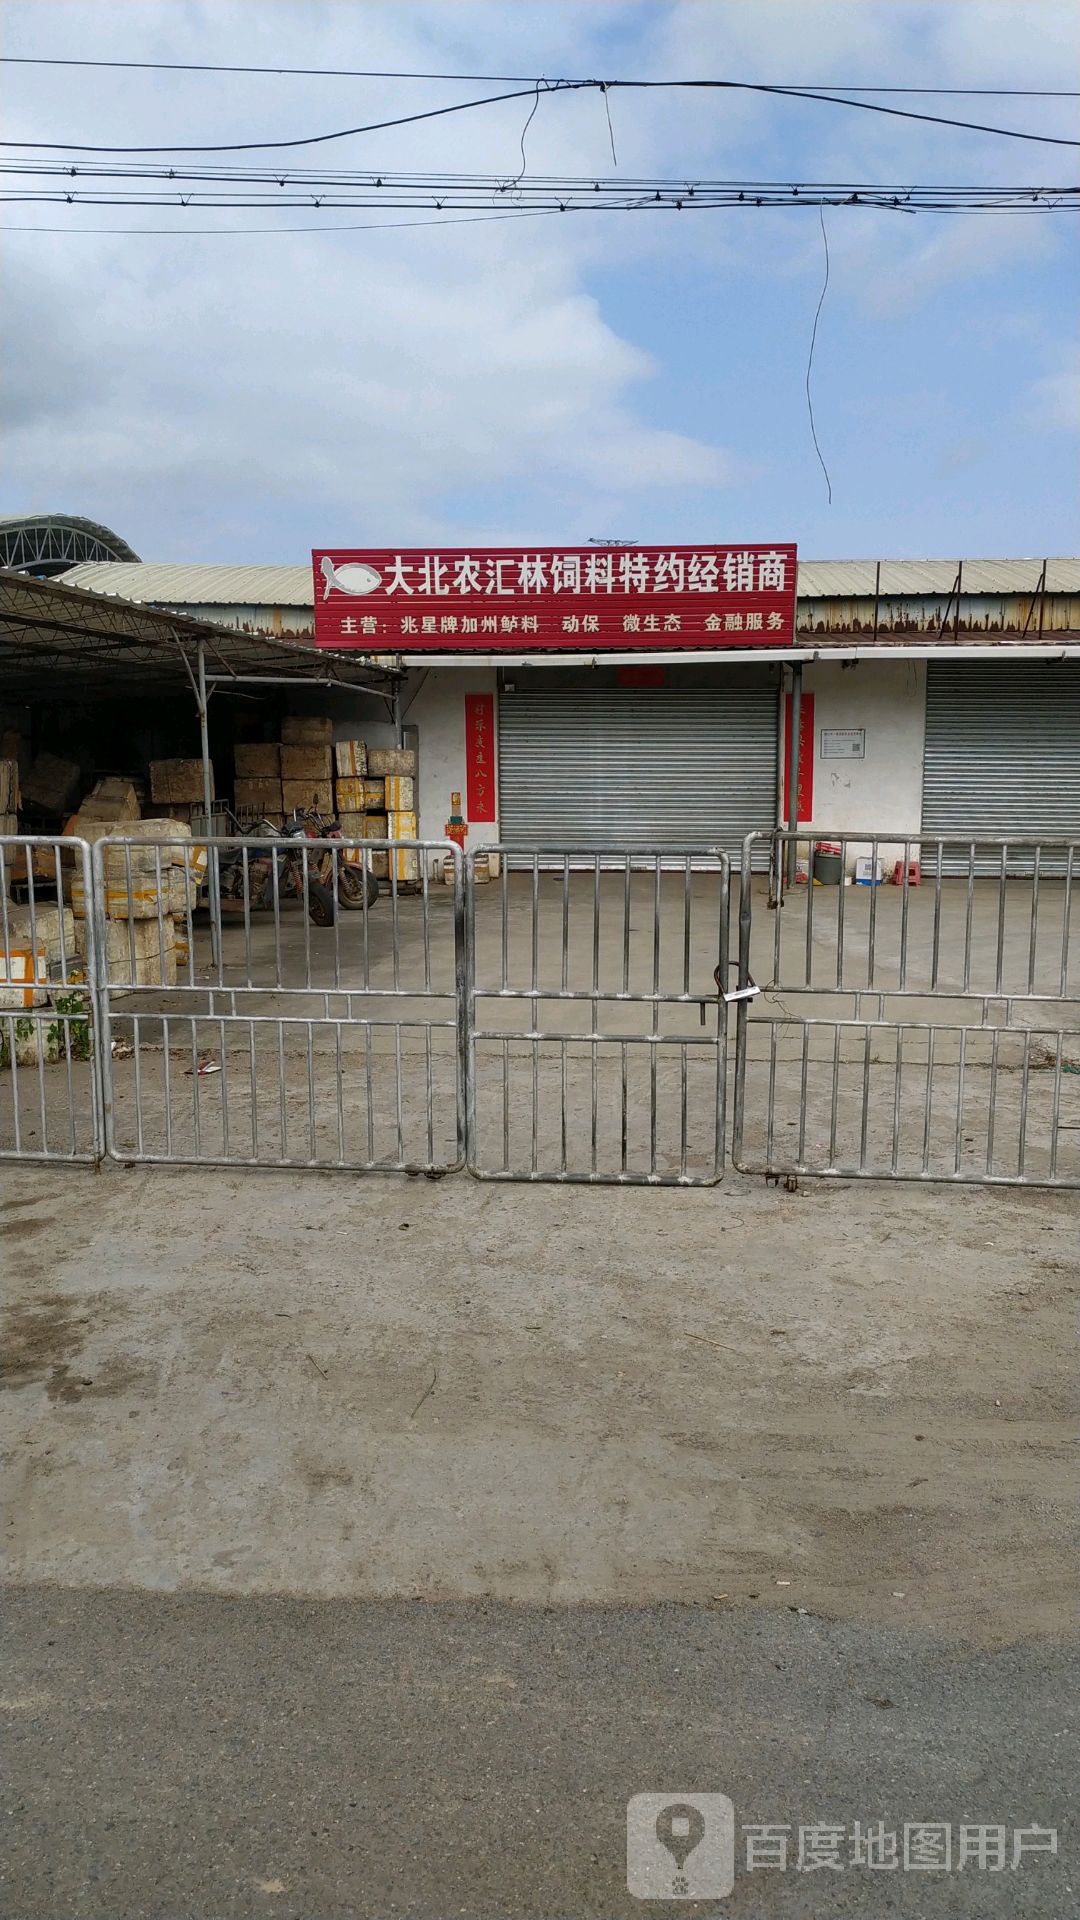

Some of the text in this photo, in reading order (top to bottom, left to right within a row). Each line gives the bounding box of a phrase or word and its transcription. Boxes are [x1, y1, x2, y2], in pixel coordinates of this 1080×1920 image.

[384, 551, 788, 595] 大北农汇林饲料特约经销商
[401, 615, 539, 634] 兆星牌加州鲈料
[562, 614, 600, 633] 动保
[623, 613, 682, 632] 微生态
[704, 611, 785, 631] 金融服务
